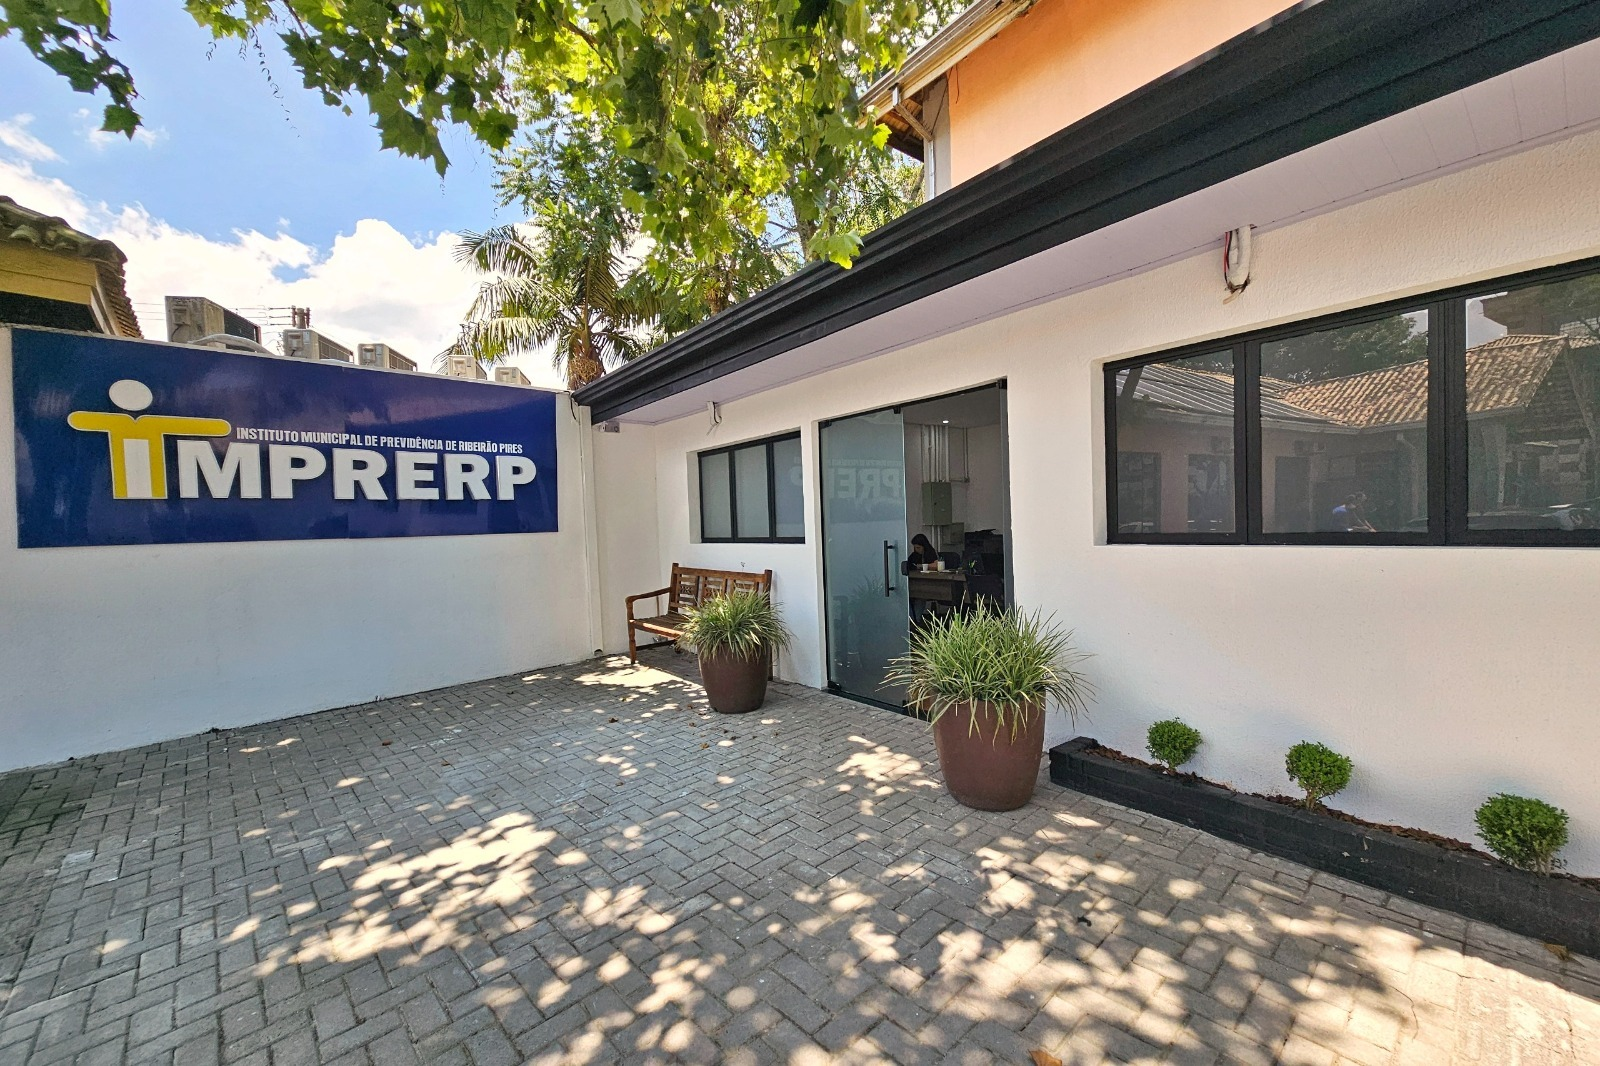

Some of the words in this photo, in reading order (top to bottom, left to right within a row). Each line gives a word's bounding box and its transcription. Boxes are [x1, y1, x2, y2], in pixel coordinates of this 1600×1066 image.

[237, 428, 298, 442] INSTITUTO
[301, 432, 362, 445] MUNICIPAL
[365, 435, 378, 446] DE
[380, 436, 443, 450] PREVIDÊNCIA
[446, 440, 457, 451] DE
[459, 440, 498, 452] RIBEIRÃO
[499, 443, 523, 454] PIRES
